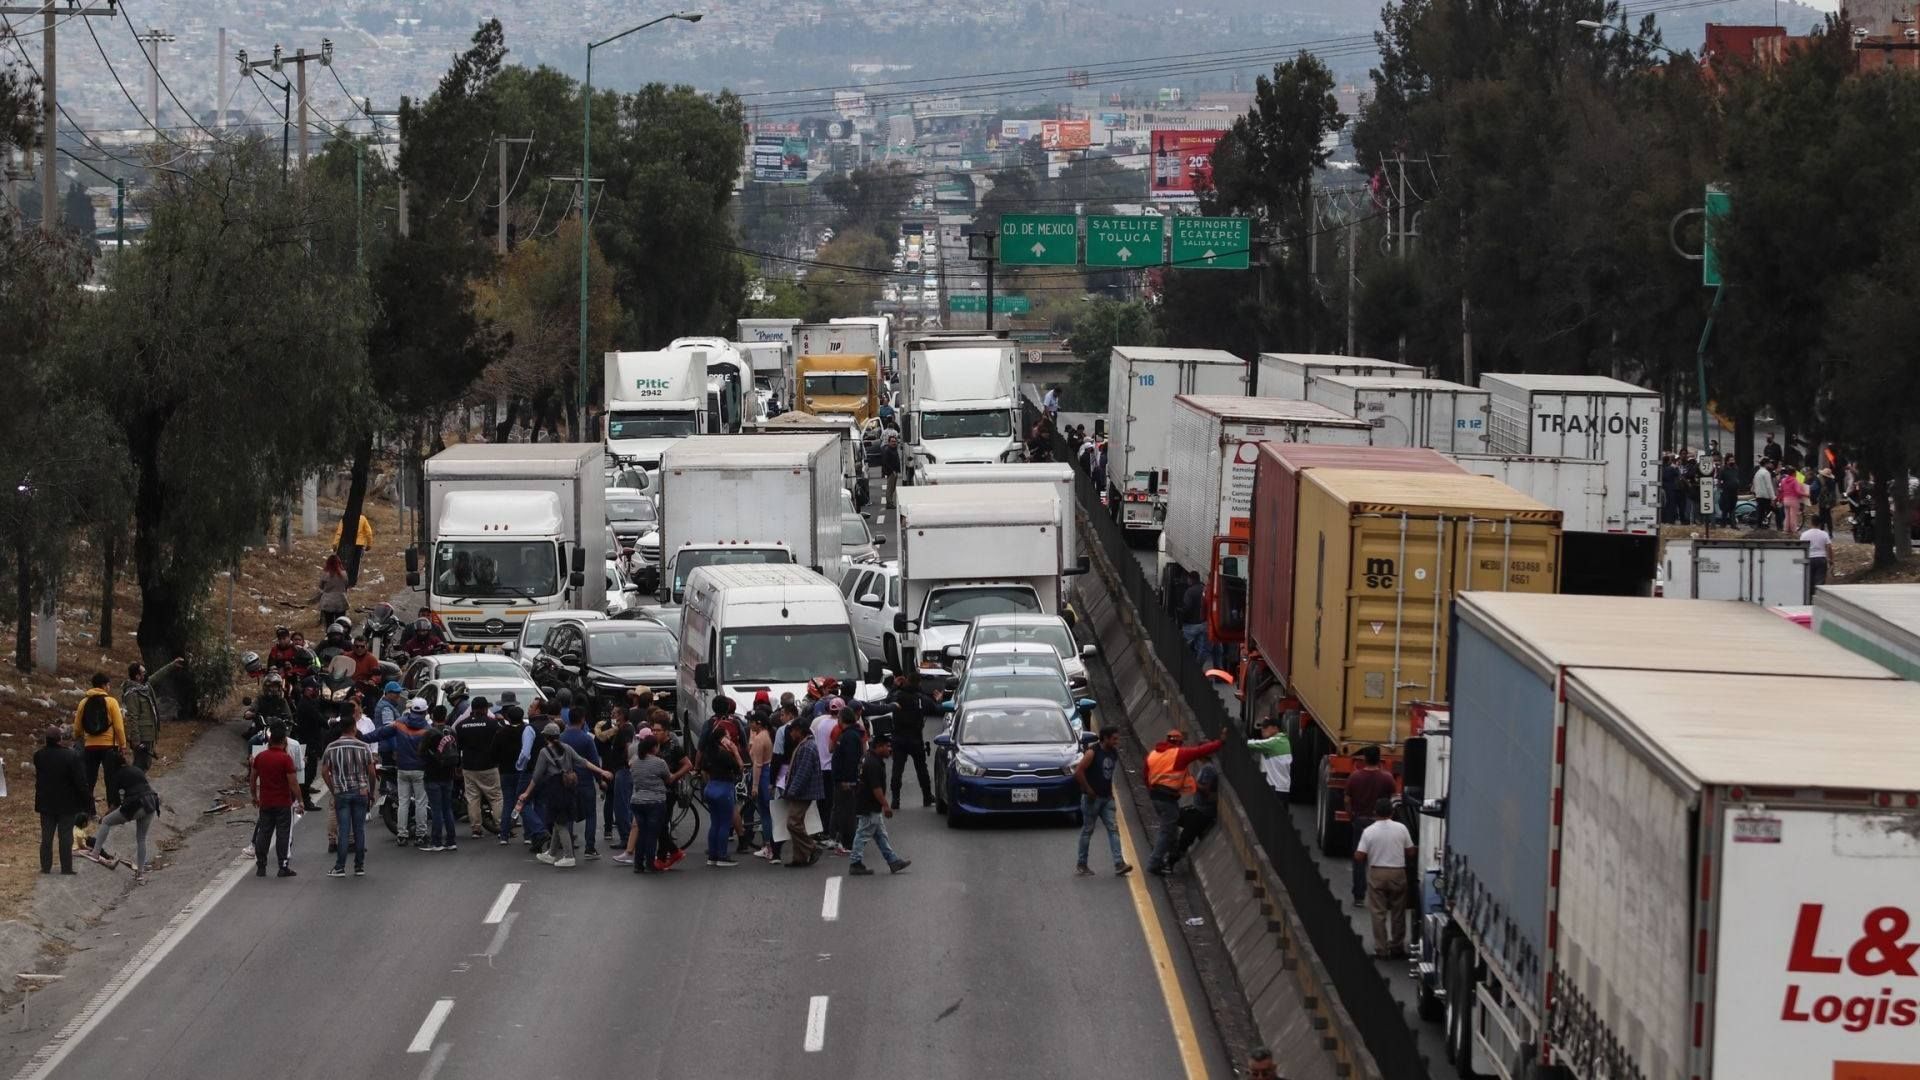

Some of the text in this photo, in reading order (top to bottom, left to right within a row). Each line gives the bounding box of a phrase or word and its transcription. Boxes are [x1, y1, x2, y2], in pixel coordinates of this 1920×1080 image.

[1003, 223, 1074, 236] CD. DE MEXICO
[1092, 220, 1158, 231] SATELITE
[1178, 220, 1243, 230] PERINORTE
[1098, 232, 1151, 243] TOLUCA
[1180, 230, 1241, 240] ECATEPEC
[830, 342, 841, 352] TIP
[636, 379, 670, 390] Pitic
[1138, 375, 1155, 386] 118
[641, 389, 662, 397] 2942
[1457, 419, 1483, 429] R 12
[1538, 412, 1641, 435] TRAXIÓN
[1641, 417, 1650, 477] R823004
[1703, 490, 1711, 499] 3
[1703, 502, 1711, 511] 5
[1480, 559, 1501, 570] MEDU
[1510, 561, 1540, 573] 463468
[1781, 984, 1920, 1032] Logis
